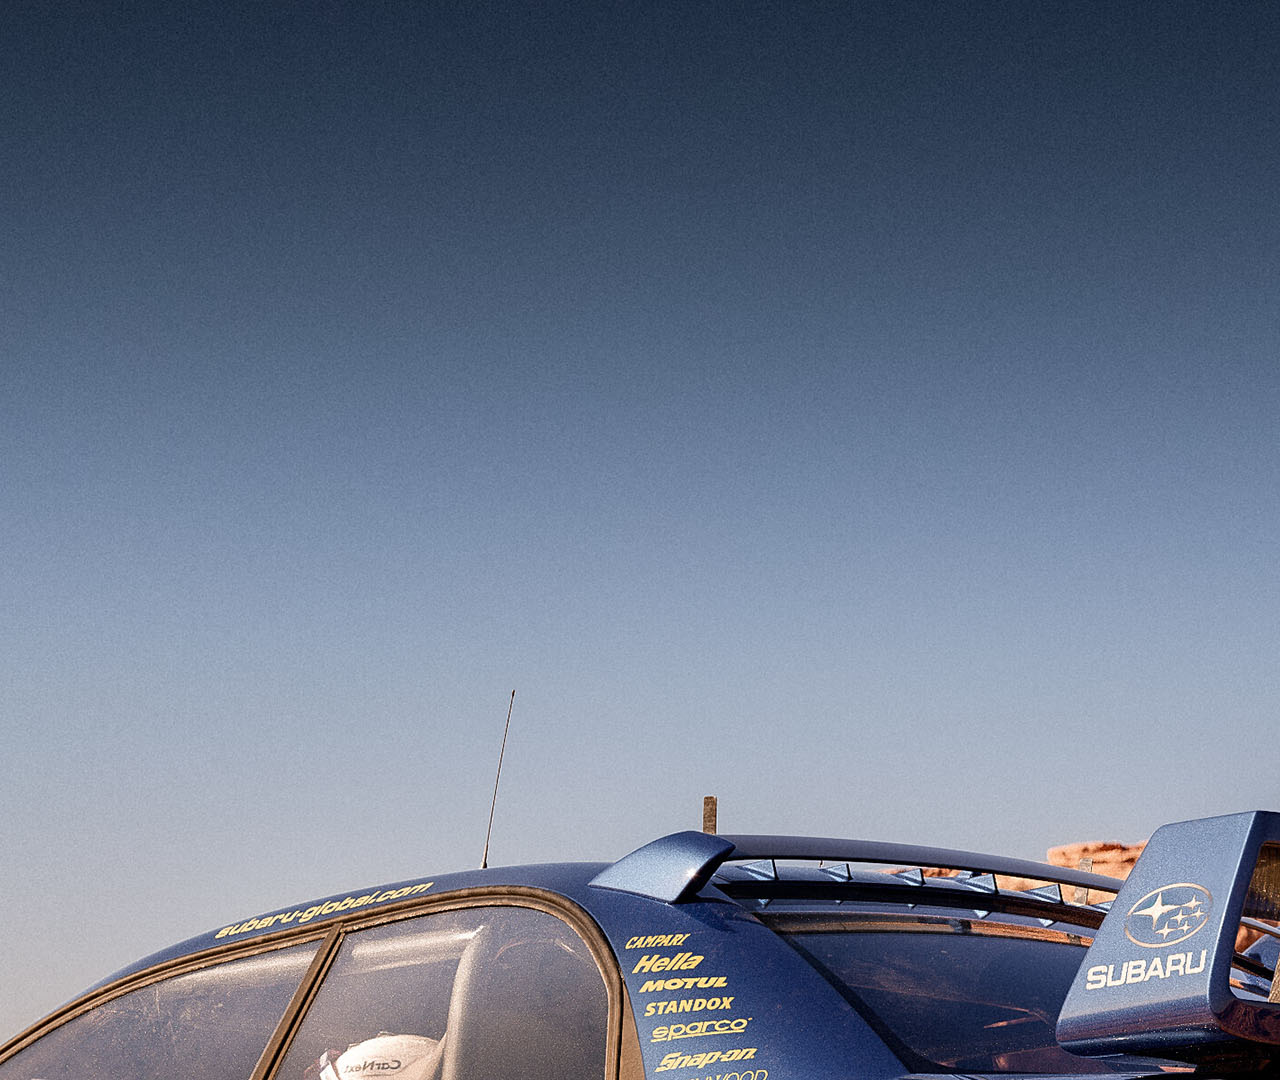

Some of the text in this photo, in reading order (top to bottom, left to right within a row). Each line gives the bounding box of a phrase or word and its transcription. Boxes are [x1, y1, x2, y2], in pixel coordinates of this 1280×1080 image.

[214, 882, 434, 939] subaru-global.com
[625, 933, 691, 950] CAMPARI
[632, 952, 704, 974] Hella
[1085, 949, 1208, 990] SUBARU
[638, 976, 728, 993] MOTUL
[644, 996, 735, 1017] STANDOX
[650, 1018, 752, 1042] sparco
